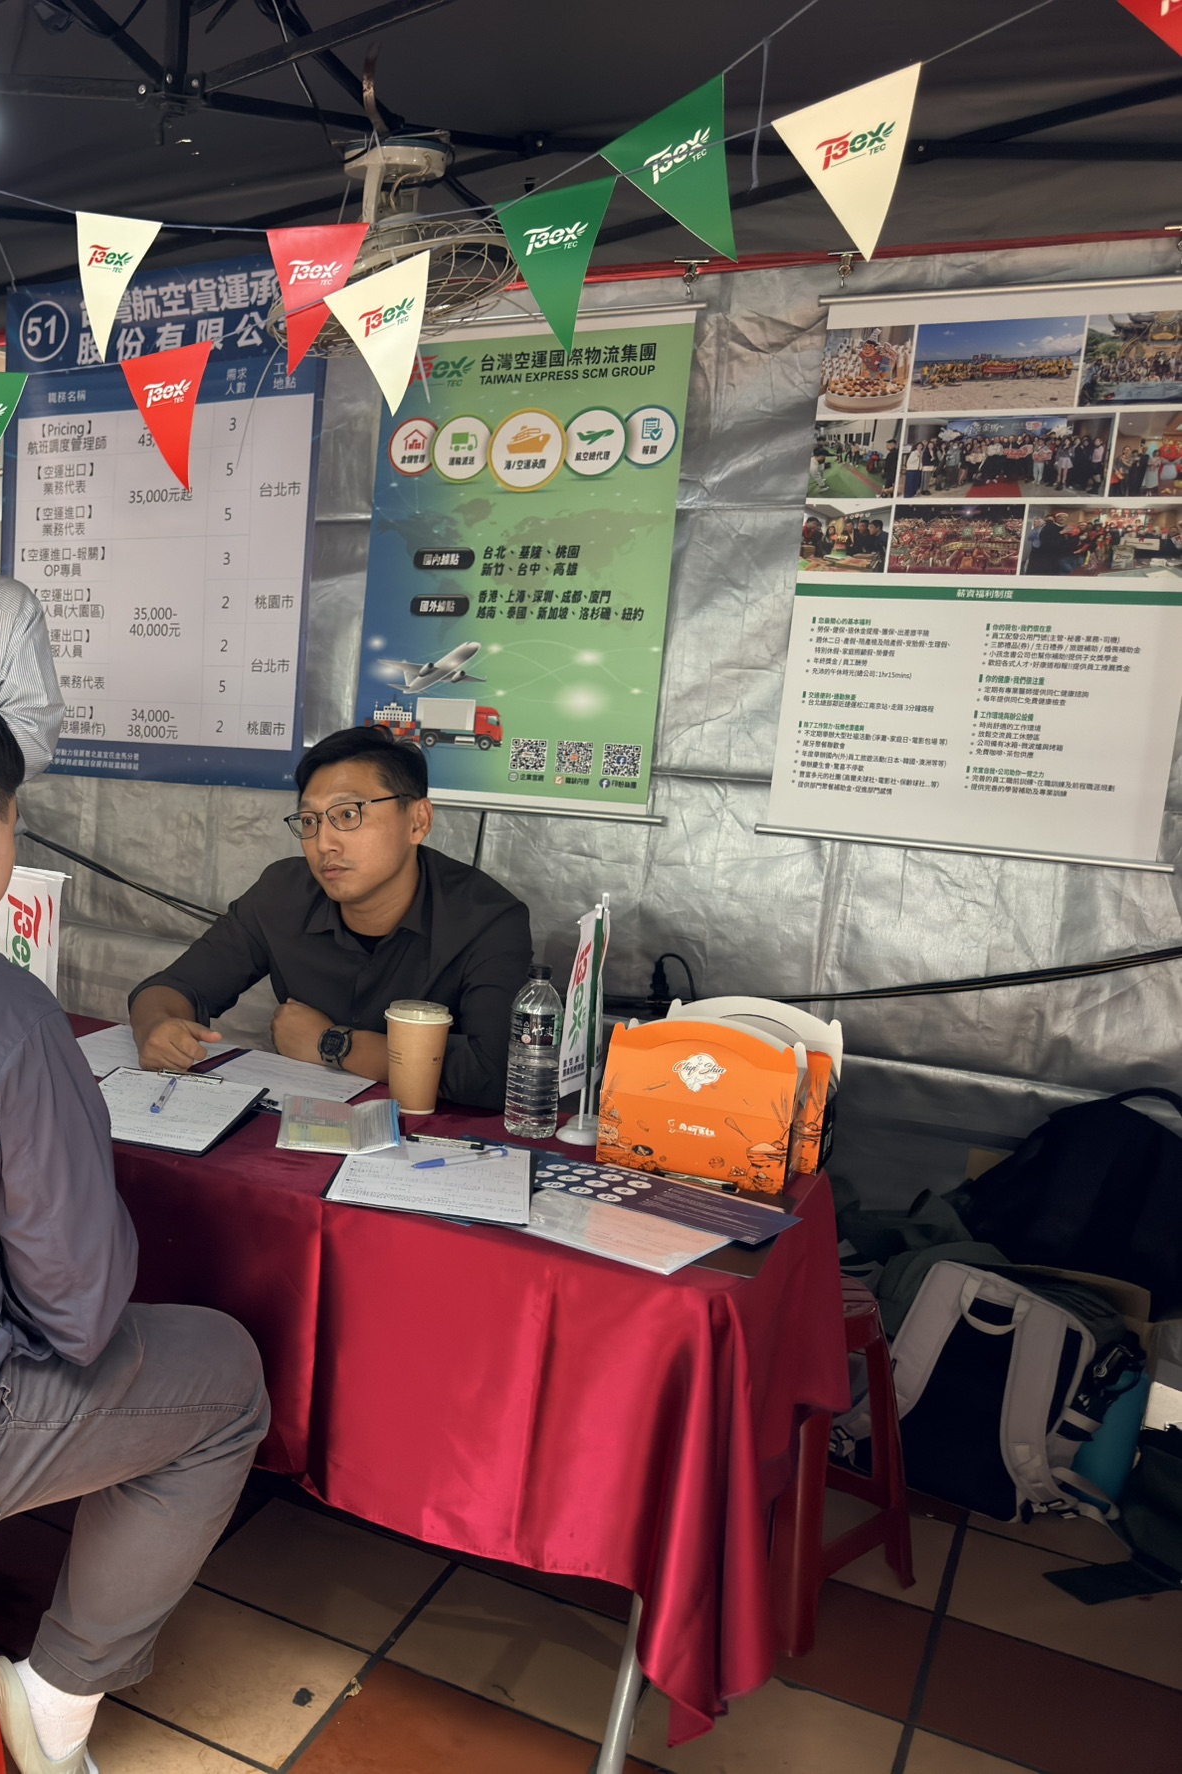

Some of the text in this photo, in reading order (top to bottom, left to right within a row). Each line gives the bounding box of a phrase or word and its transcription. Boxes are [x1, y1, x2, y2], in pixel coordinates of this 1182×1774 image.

[692, 149, 707, 163] TEC
[869, 143, 886, 156] TEC
[562, 240, 579, 251] TEC
[112, 266, 123, 274] TEC
[319, 278, 333, 286] TEC
[396, 315, 409, 325] TEC
[27, 316, 56, 347] 51
[77, 312, 286, 365] 股份有限公
[480, 342, 657, 372] 台灣空運國際物流集團
[226, 367, 248, 380] 需求
[479, 364, 656, 386] TAIWAN EXPRESS SCM GROUP
[225, 381, 246, 395] 人數
[273, 376, 296, 390] 地點
[48, 390, 86, 403] 職務名稱
[173, 395, 185, 403] TEC
[229, 417, 237, 431] 3
[27, 436, 107, 455] 航班調度管理師
[226, 462, 234, 476] 5
[43, 480, 86, 495] 業務代表
[259, 481, 301, 498] 台北市
[129, 487, 193, 504] 35,000元起
[224, 507, 232, 521] 5
[42, 522, 86, 537] 業務代表
[223, 552, 231, 565] 3
[44, 563, 82, 578] OP專員
[480, 562, 579, 577] 新竹、台中、高雄
[956, 588, 1014, 601] 薪資福利制度
[221, 596, 230, 609] 2
[254, 595, 294, 609] 桃園市
[133, 607, 178, 622] 35,000-
[47, 629, 90, 643] 運出口】
[129, 623, 181, 638] 40,000元
[220, 639, 228, 652] 2
[251, 658, 290, 673] 台北市
[218, 680, 226, 693] 5
[130, 708, 175, 724] 34,000-
[126, 724, 178, 740] 38,000元
[215, 720, 224, 734] 2
[246, 720, 286, 736] 桃園市
